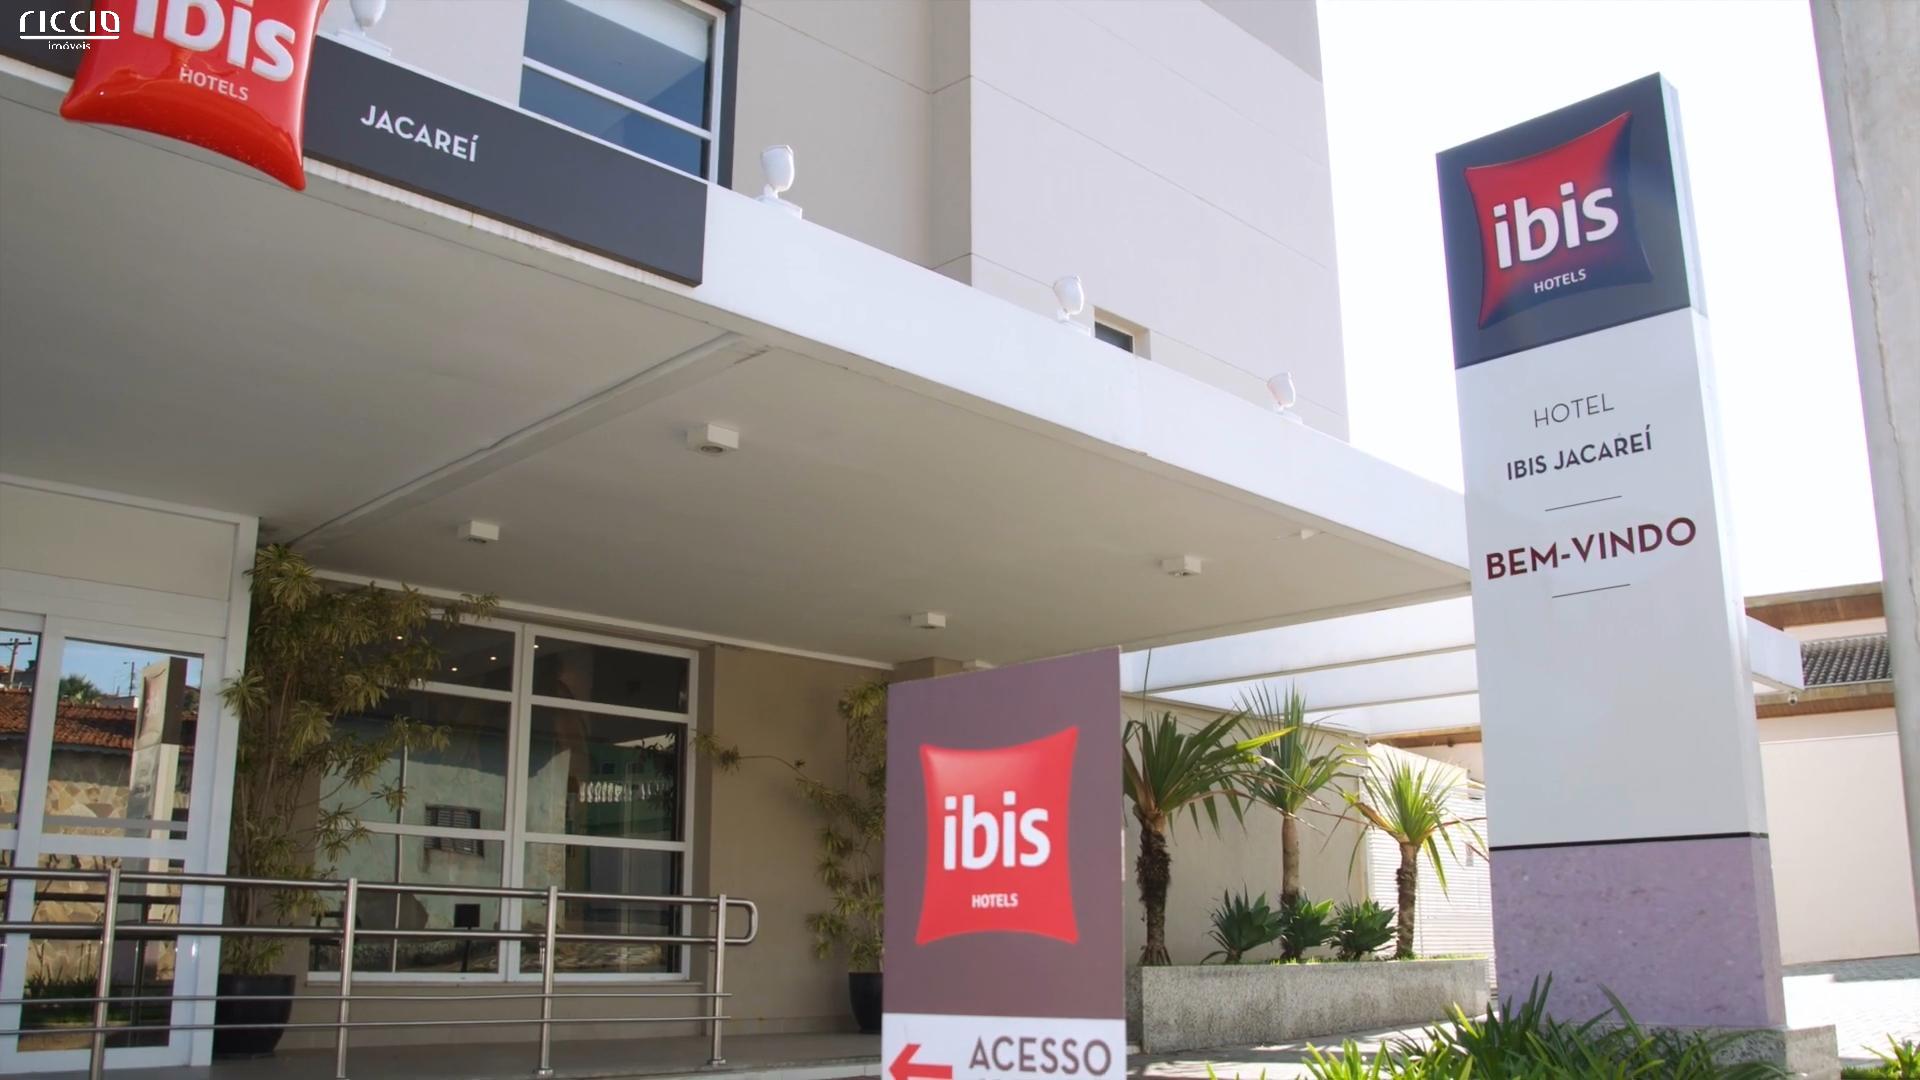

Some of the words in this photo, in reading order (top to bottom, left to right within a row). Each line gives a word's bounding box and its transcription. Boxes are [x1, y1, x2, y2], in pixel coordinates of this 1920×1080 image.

[179, 66, 249, 101] HOTELS
[360, 105, 479, 162] JACAREÍ
[1493, 181, 1619, 269] ibis
[1533, 268, 1587, 294] HOTELS
[1534, 393, 1615, 428] HOTEL
[1507, 455, 1547, 480] IBIS
[1553, 424, 1653, 470] JACAREÍ
[1486, 517, 1696, 580] BEM-VINDO
[943, 791, 1051, 871] ibis
[971, 893, 1019, 908] HOTELS
[968, 1035, 1112, 1076] ACESSO
